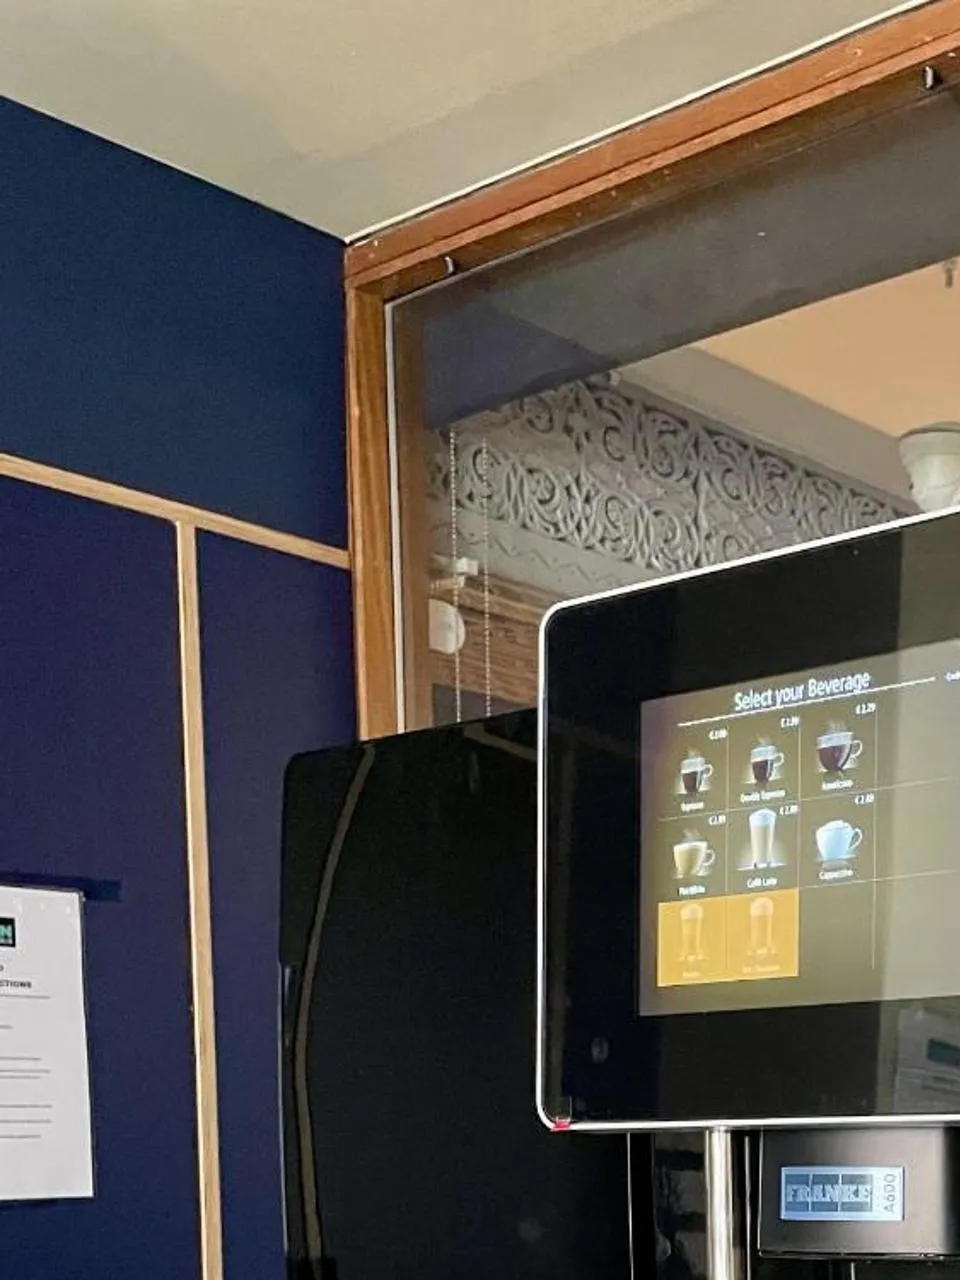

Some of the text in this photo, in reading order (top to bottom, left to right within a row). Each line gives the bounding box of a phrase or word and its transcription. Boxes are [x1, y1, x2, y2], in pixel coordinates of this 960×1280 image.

[734, 670, 872, 711] Select your Beverage
